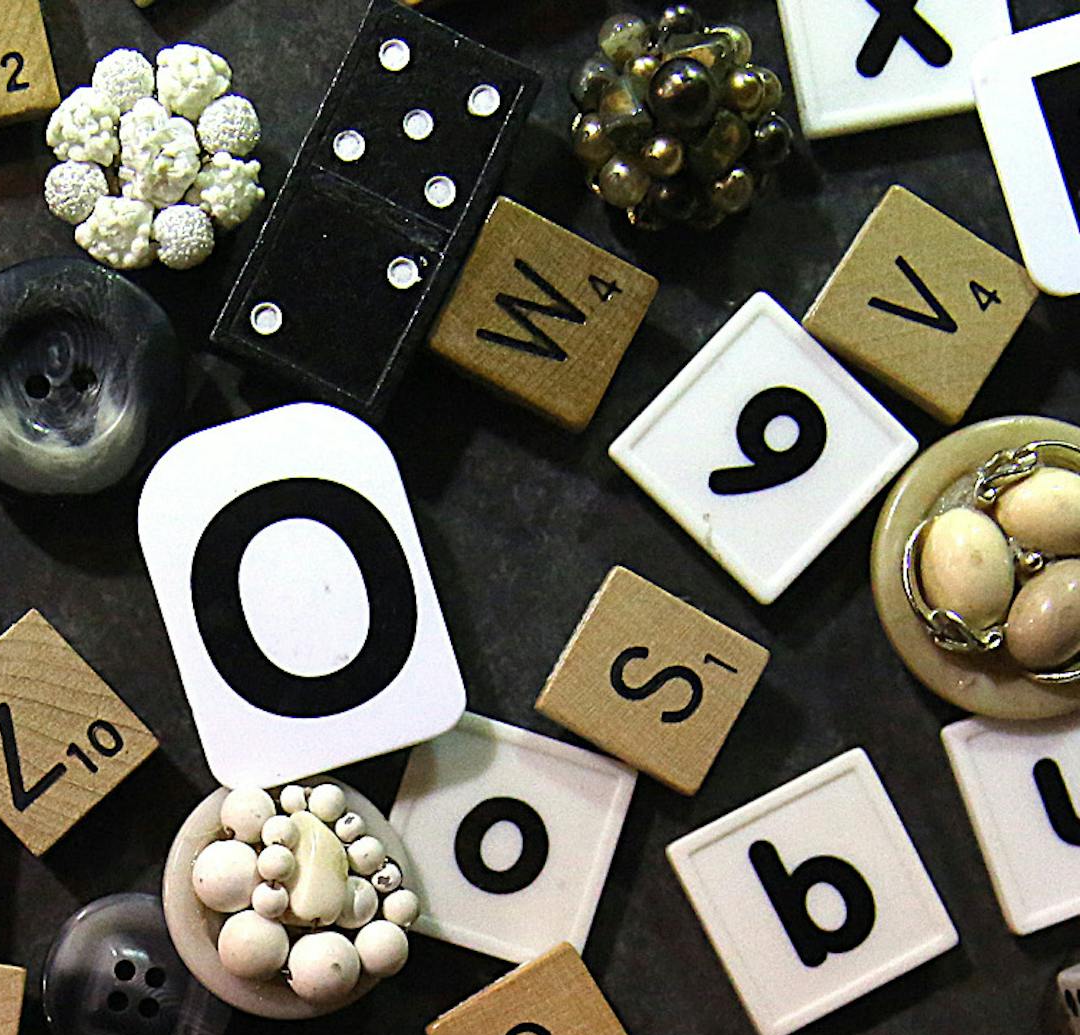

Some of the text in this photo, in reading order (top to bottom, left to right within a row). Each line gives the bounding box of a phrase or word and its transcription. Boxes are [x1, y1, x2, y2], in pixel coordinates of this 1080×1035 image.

[476, 258, 587, 362] W
[868, 256, 958, 333] V
[610, 646, 703, 723] S
[67, 719, 123, 773] 10
[748, 840, 876, 968] b
